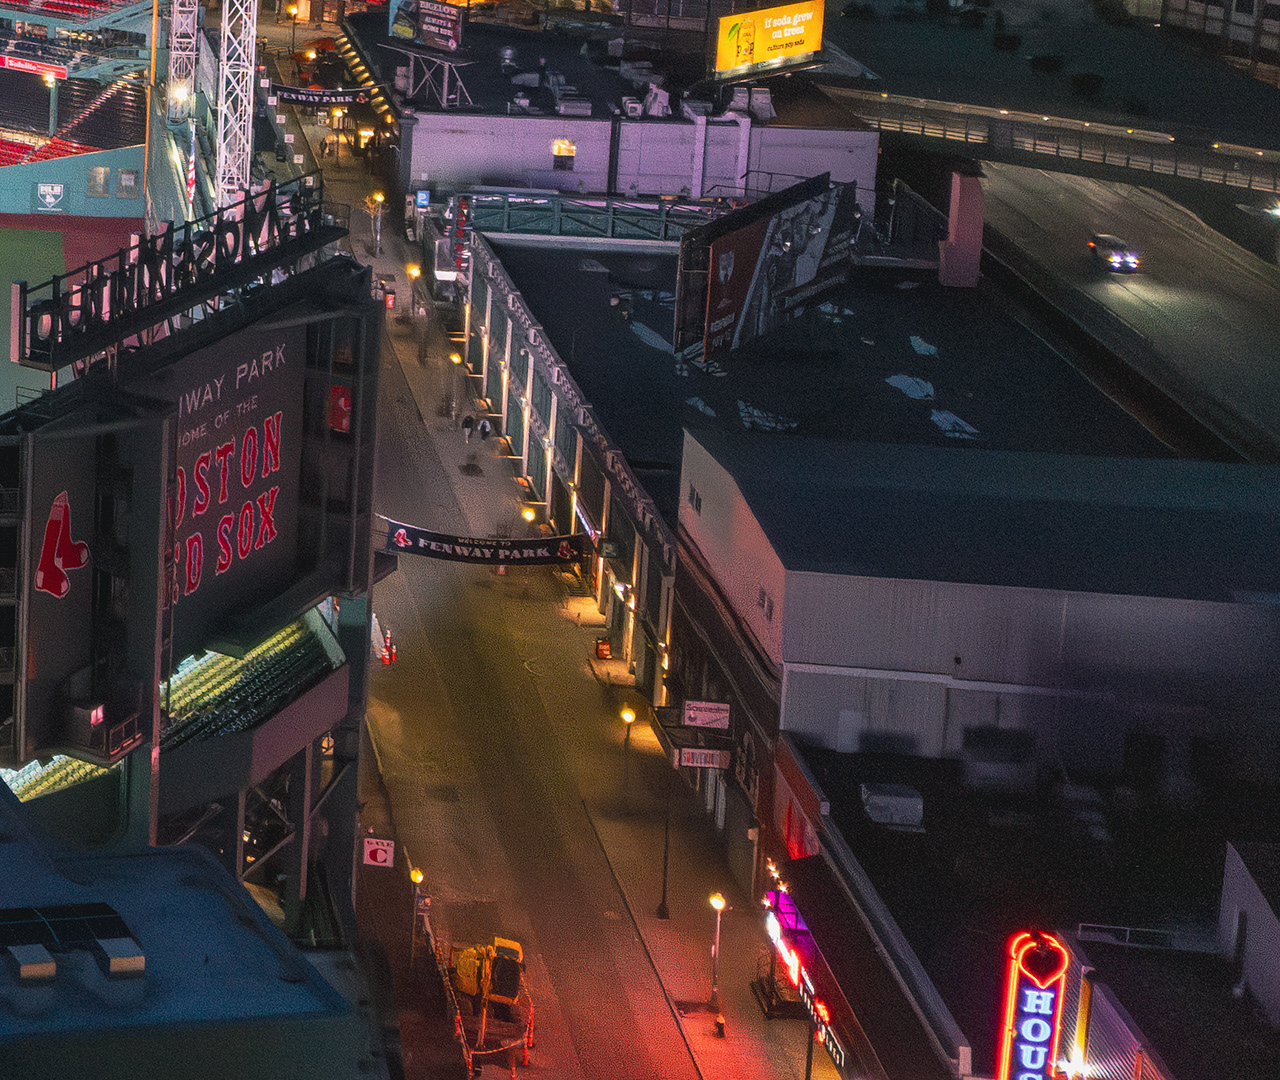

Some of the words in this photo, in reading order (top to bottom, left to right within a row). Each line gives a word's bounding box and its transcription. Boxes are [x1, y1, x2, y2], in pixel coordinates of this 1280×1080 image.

[420, 0, 458, 16] BIGELOW
[764, 18, 772, 28] if
[772, 15, 791, 27] soda
[792, 11, 814, 26] grow
[772, 29, 783, 39] on
[784, 25, 805, 37] trees
[179, 374, 226, 418] WAY
[236, 343, 286, 389] PARK
[214, 410, 230, 429] OF
[236, 395, 259, 416] THE
[215, 485, 280, 577] SOX
[418, 537, 494, 559] FENWAY
[498, 546, 551, 560] PARK
[458, 537, 497, 546] WELCOME
